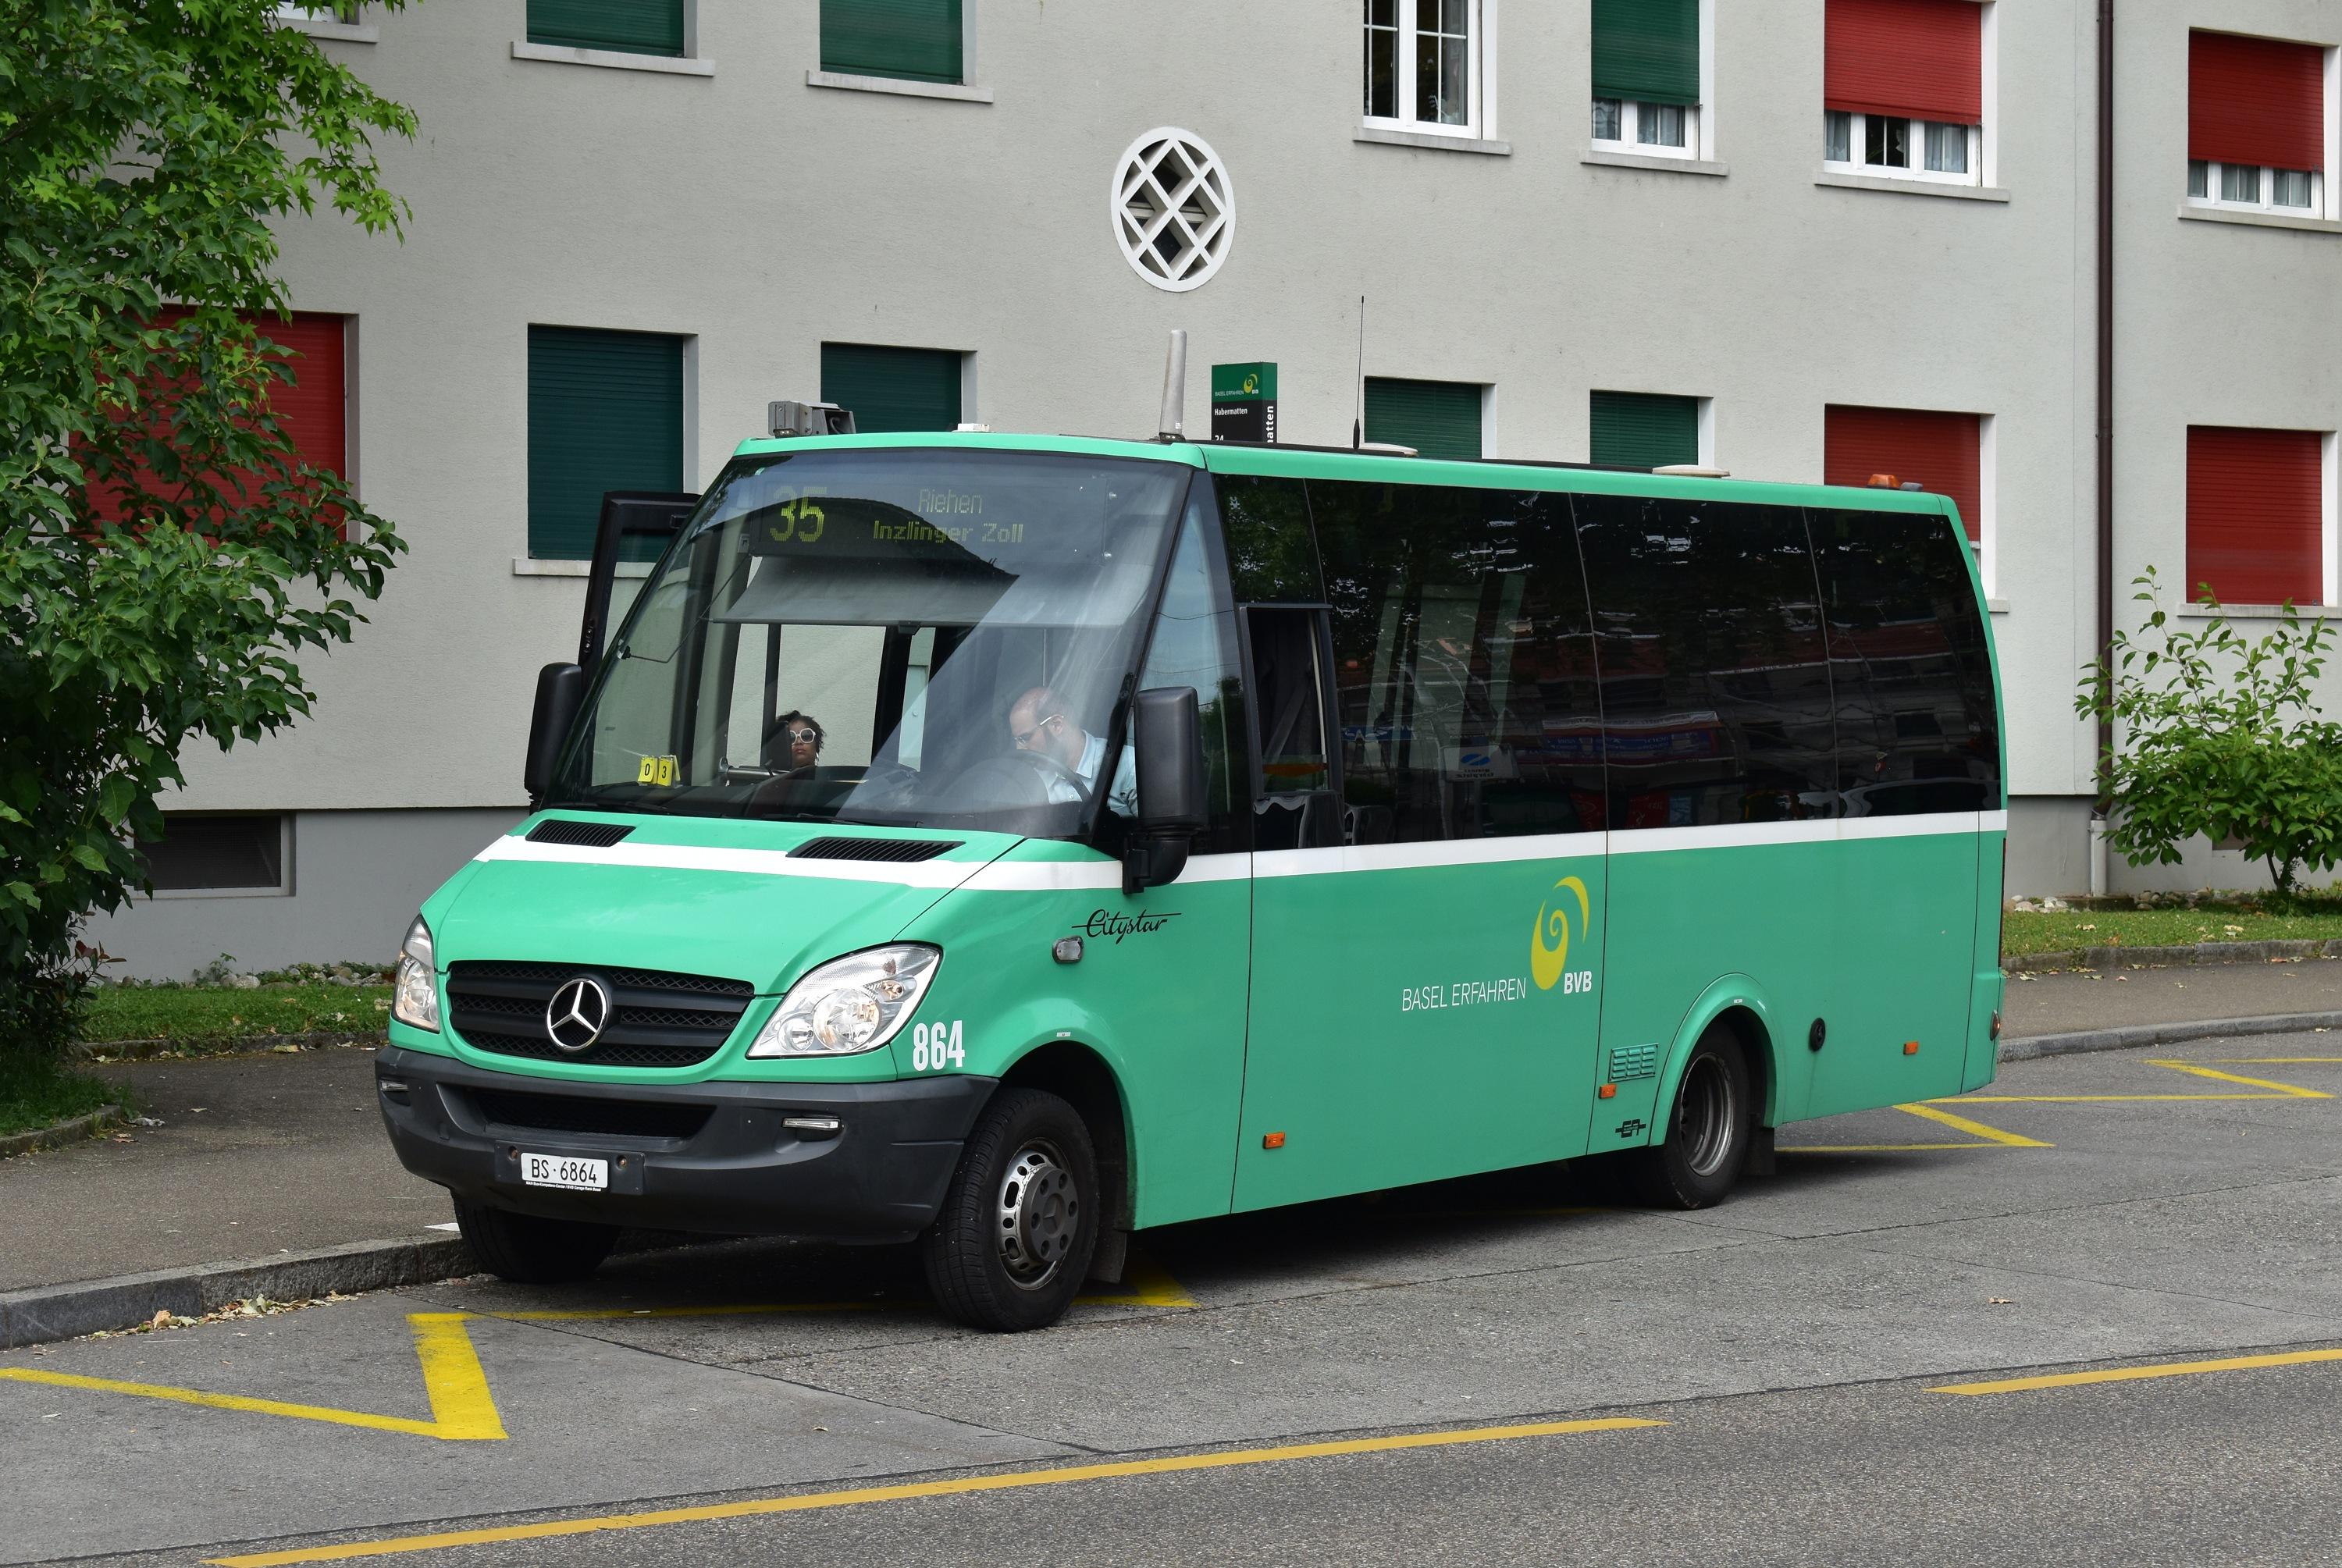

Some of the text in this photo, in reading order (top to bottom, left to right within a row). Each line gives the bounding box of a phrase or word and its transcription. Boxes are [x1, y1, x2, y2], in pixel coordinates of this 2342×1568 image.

[769, 485, 828, 542] 35
[917, 488, 983, 514] Riehen
[873, 520, 1024, 543] Inzlinger Zoll
[662, 766, 667, 778] 3
[1071, 908, 1182, 944] Citystar
[1402, 977, 1527, 1012] BASEL ERFAHREN
[1564, 970, 1593, 994] BVB
[913, 1019, 966, 1072] 864
